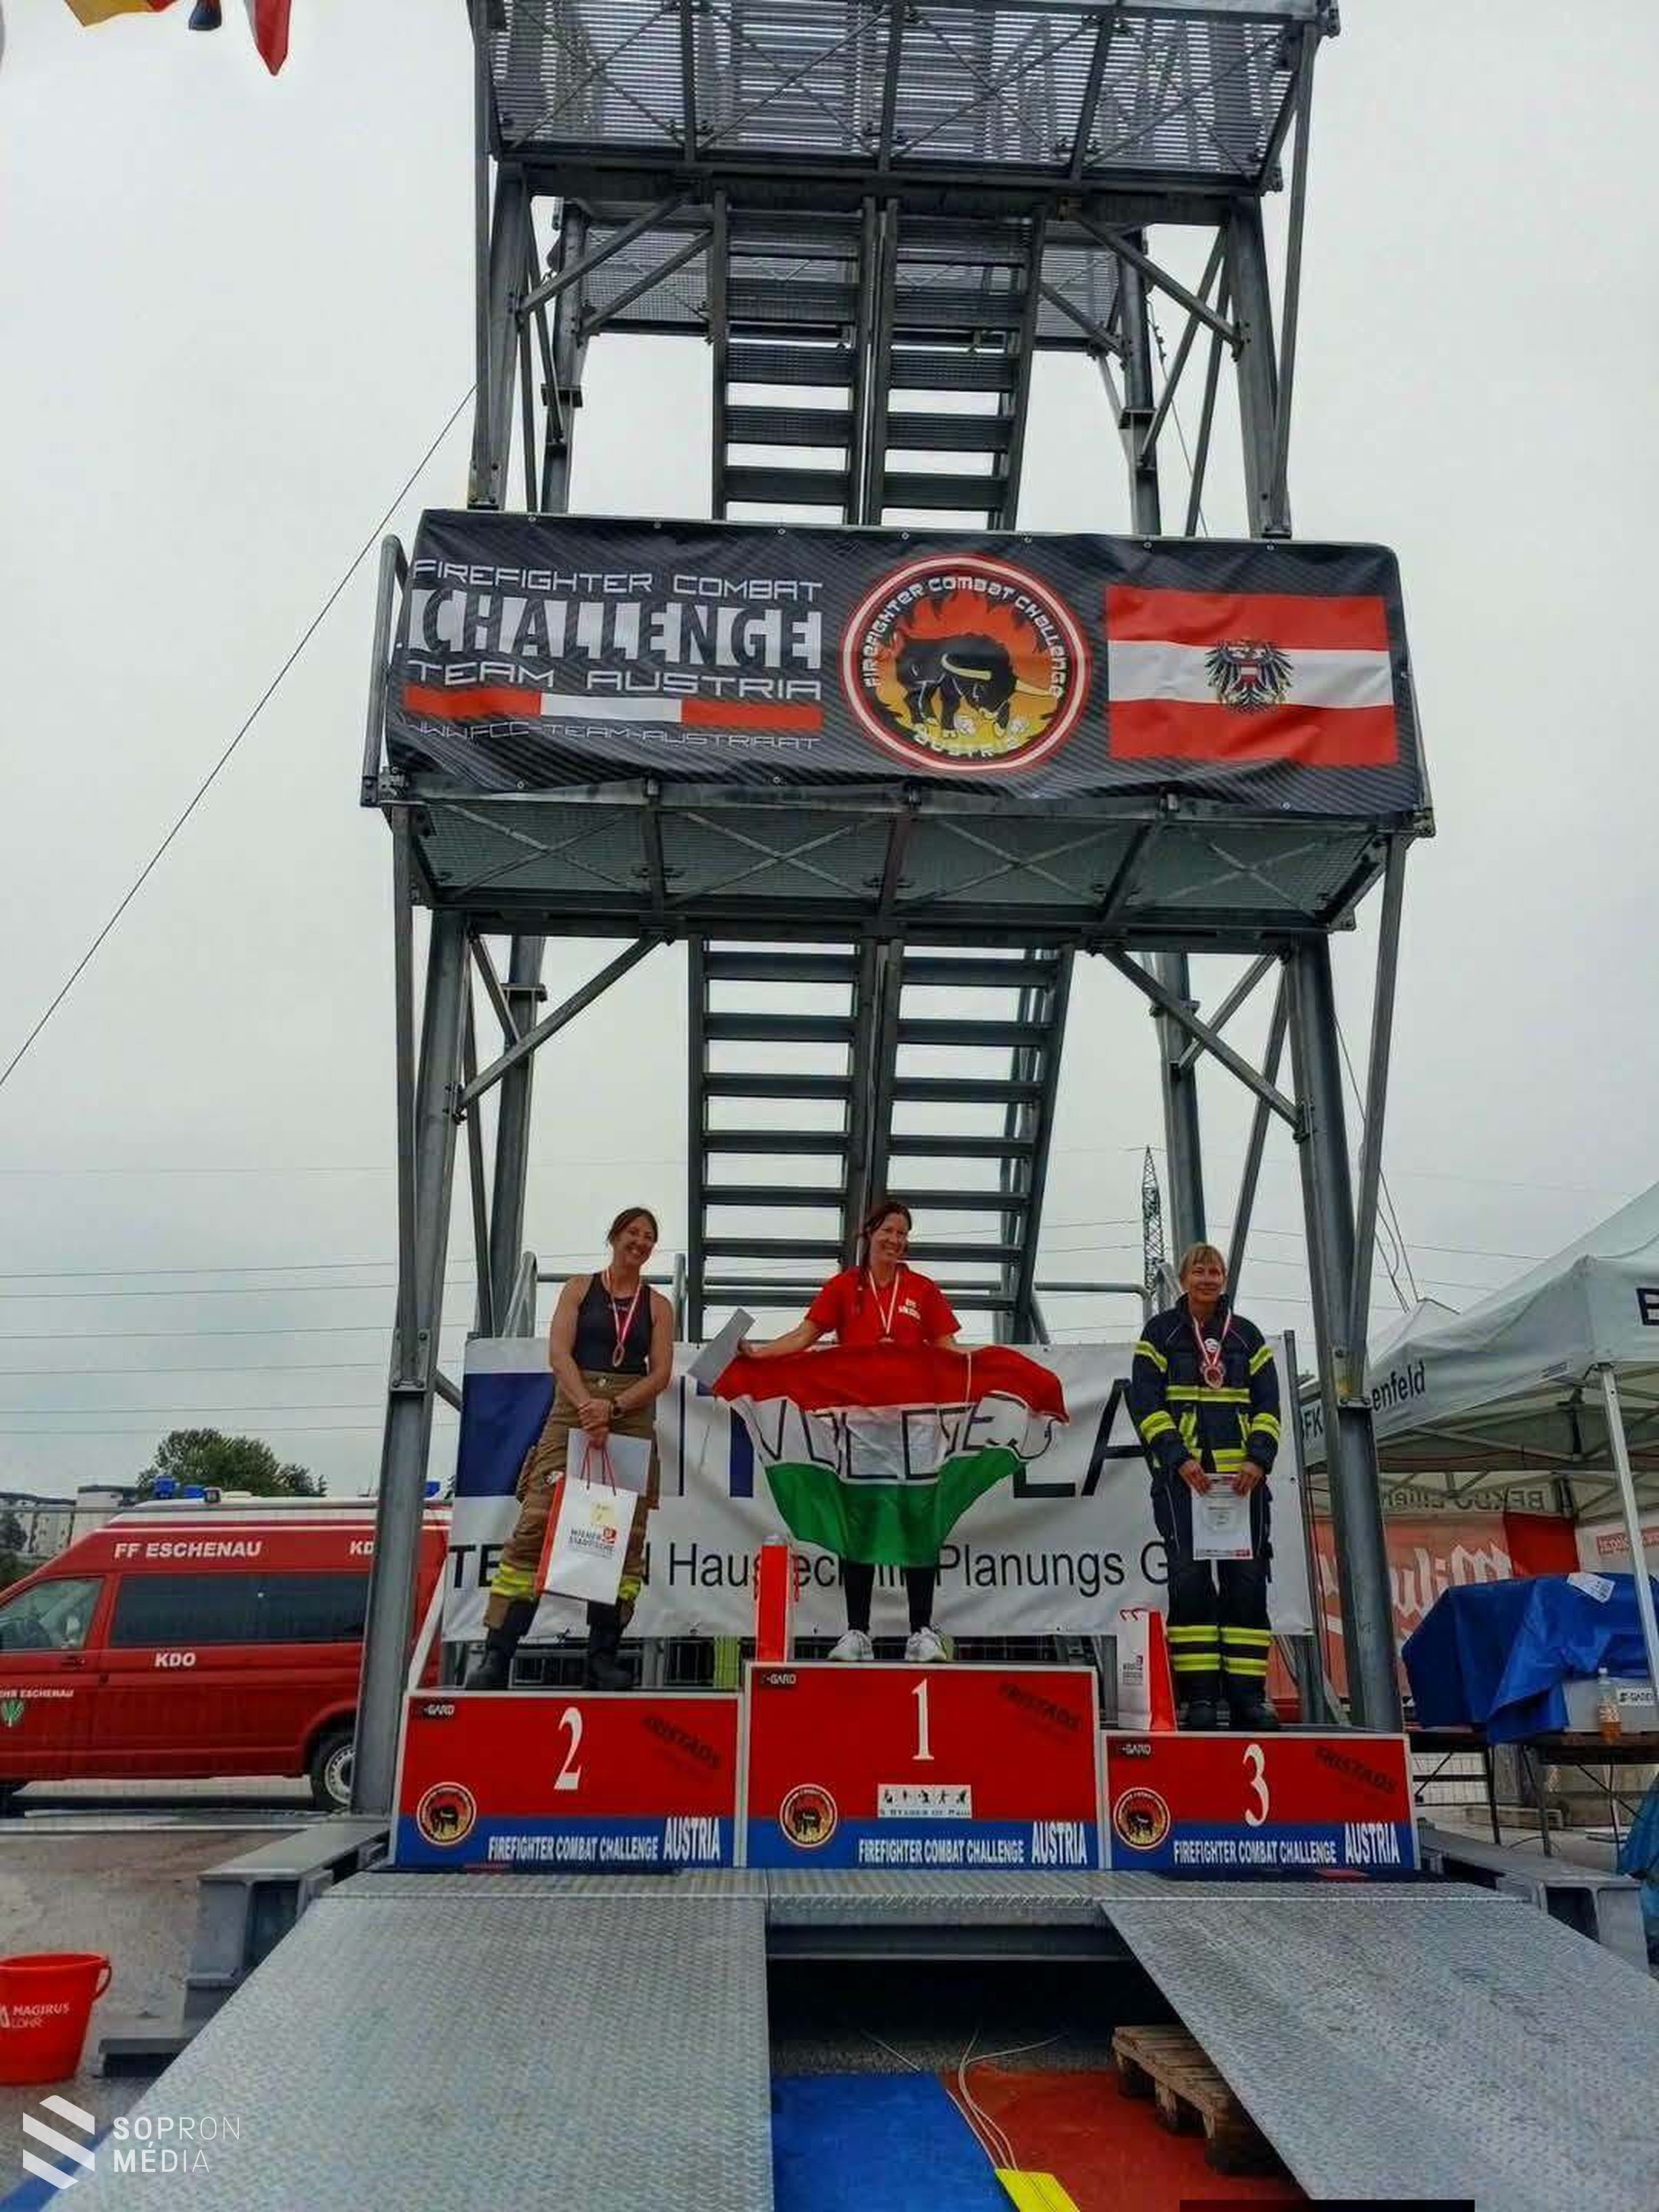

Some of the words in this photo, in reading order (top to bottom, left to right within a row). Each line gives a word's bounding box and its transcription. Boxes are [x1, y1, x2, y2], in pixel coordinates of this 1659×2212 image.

[412, 560, 652, 594] FIREFIGHTER
[673, 575, 823, 602] COMBAT
[415, 590, 821, 670] CHALLENGE
[408, 661, 554, 687] TEAM
[587, 672, 821, 700] AUSTRIA
[1371, 1360, 1426, 1411] enfeld
[114, 1543, 145, 1559] FF
[146, 1541, 262, 1558] ESCHENAU
[349, 1541, 375, 1555] KD
[937, 1544, 1124, 1597] Planungs
[154, 1652, 196, 1667] KDO
[912, 1678, 935, 1761] 1
[554, 1707, 584, 1790] 2
[1243, 1743, 1270, 1827] 3
[488, 1836, 555, 1861] FIREFIGHTER
[555, 1837, 598, 1861] COMBAT
[600, 1837, 658, 1861] CHALLENGE
[664, 1817, 720, 1861] AUSTRIA
[859, 1839, 922, 1864] FIREFIGHTER
[924, 1840, 965, 1864] COMBAT
[967, 1840, 1024, 1863] CHALLENGE
[1031, 1821, 1088, 1865] AUSTRIA
[1174, 1840, 1237, 1864] FIREFIGHTER
[1237, 1841, 1278, 1864] COMBAT
[1280, 1841, 1337, 1864] CHALLENGE
[1345, 1823, 1401, 1864] AUSTRIA
[13, 2003, 70, 2015] MAGIRUS
